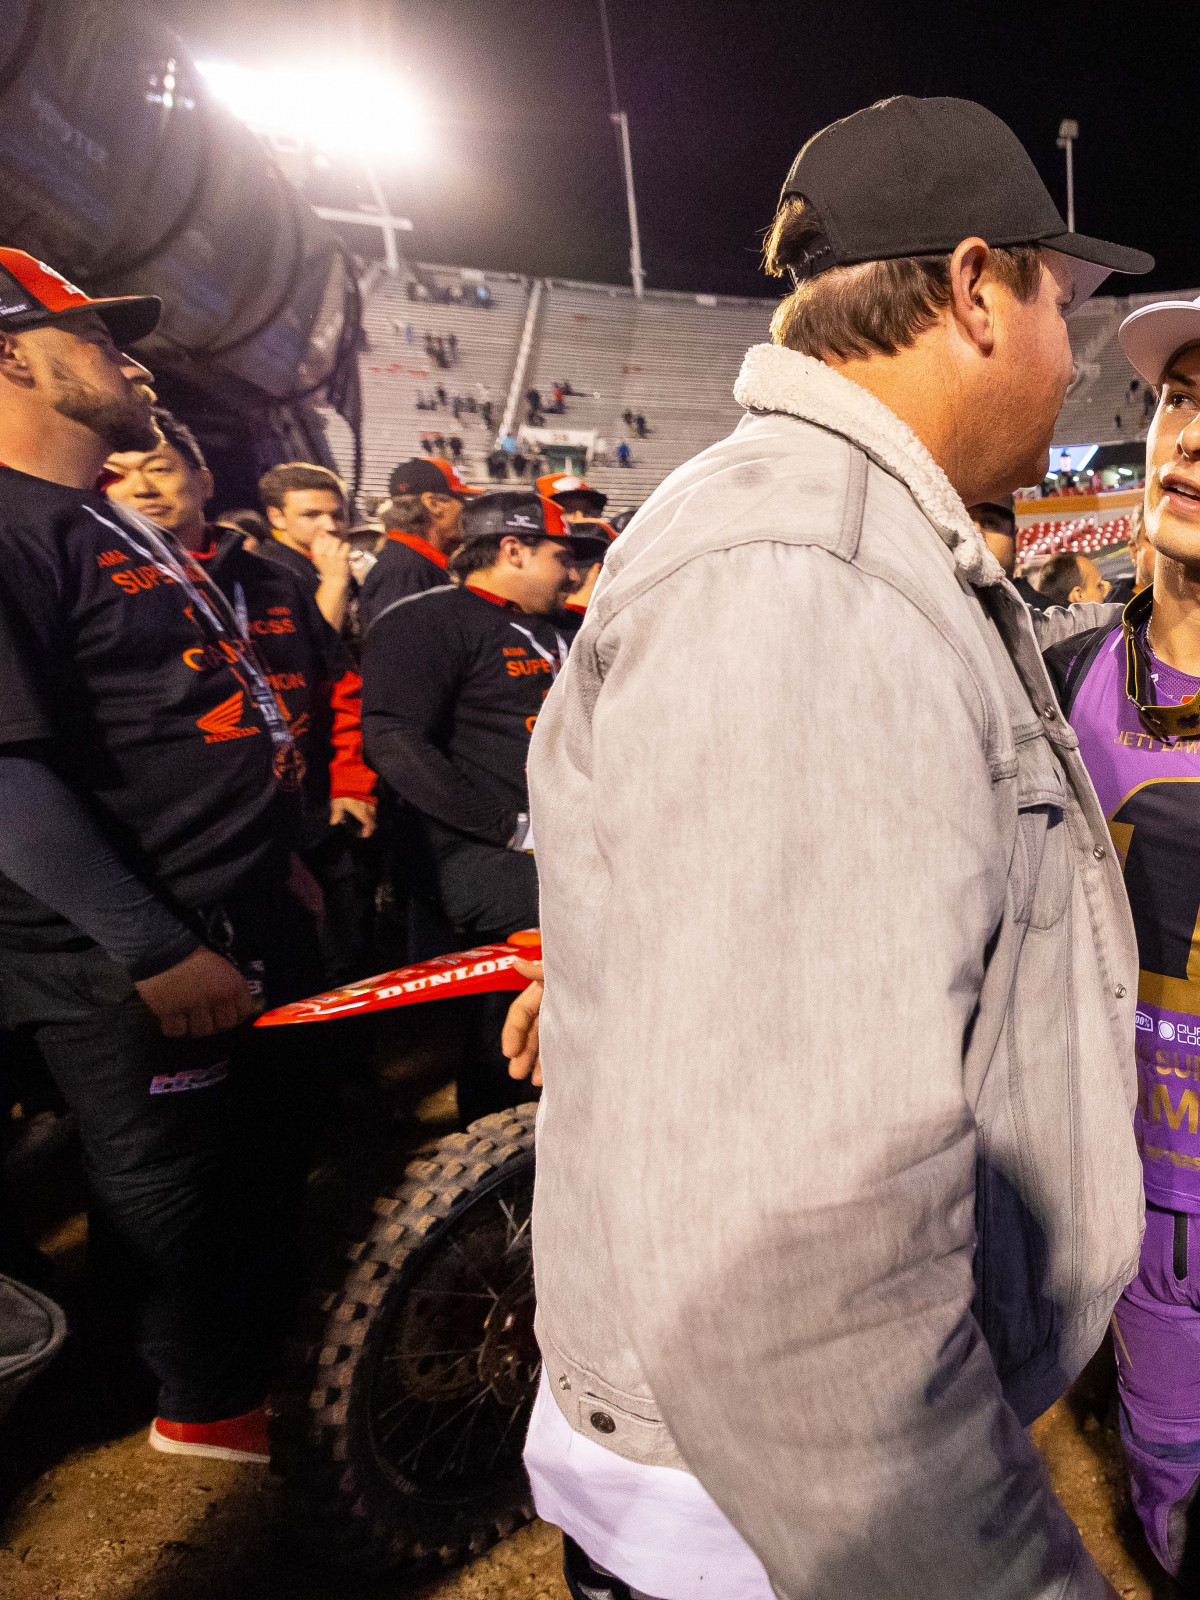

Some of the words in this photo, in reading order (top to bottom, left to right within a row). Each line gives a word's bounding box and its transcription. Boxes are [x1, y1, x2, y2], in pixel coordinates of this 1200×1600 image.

[506, 659, 553, 677] SUPE
[1113, 730, 1156, 750] JETT
[376, 955, 518, 1000] DUNLOP
[1135, 1015, 1151, 1029] 00%
